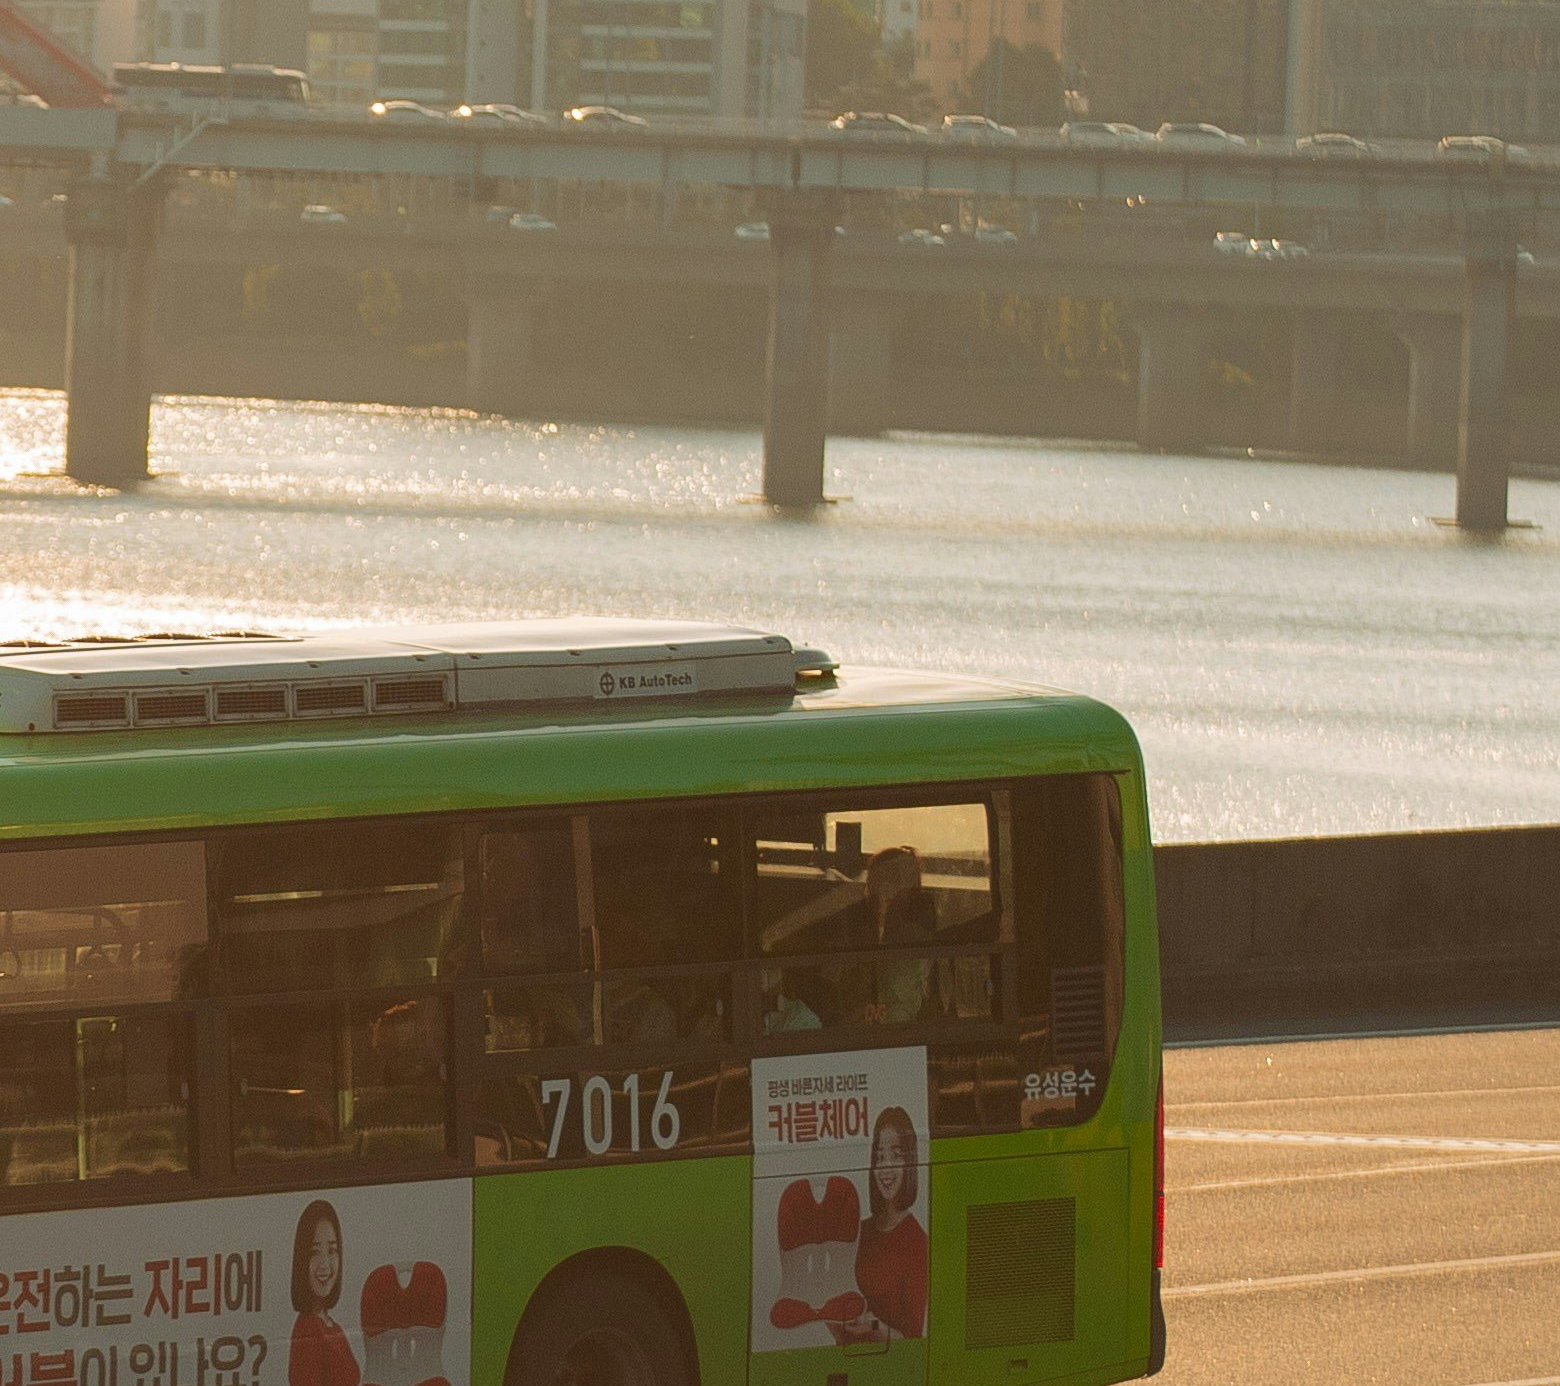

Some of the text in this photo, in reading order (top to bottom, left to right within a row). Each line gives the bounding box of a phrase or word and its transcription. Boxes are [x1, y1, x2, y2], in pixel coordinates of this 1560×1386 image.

[619, 672, 693, 689] KB AutoTech
[767, 1073, 869, 1099] 평생 바른자세 라이프
[1023, 1068, 1097, 1101] 유성운수
[541, 1070, 680, 1159] 7016
[767, 1096, 870, 1144] 커블체어
[142, 1249, 263, 1320] 자리에
